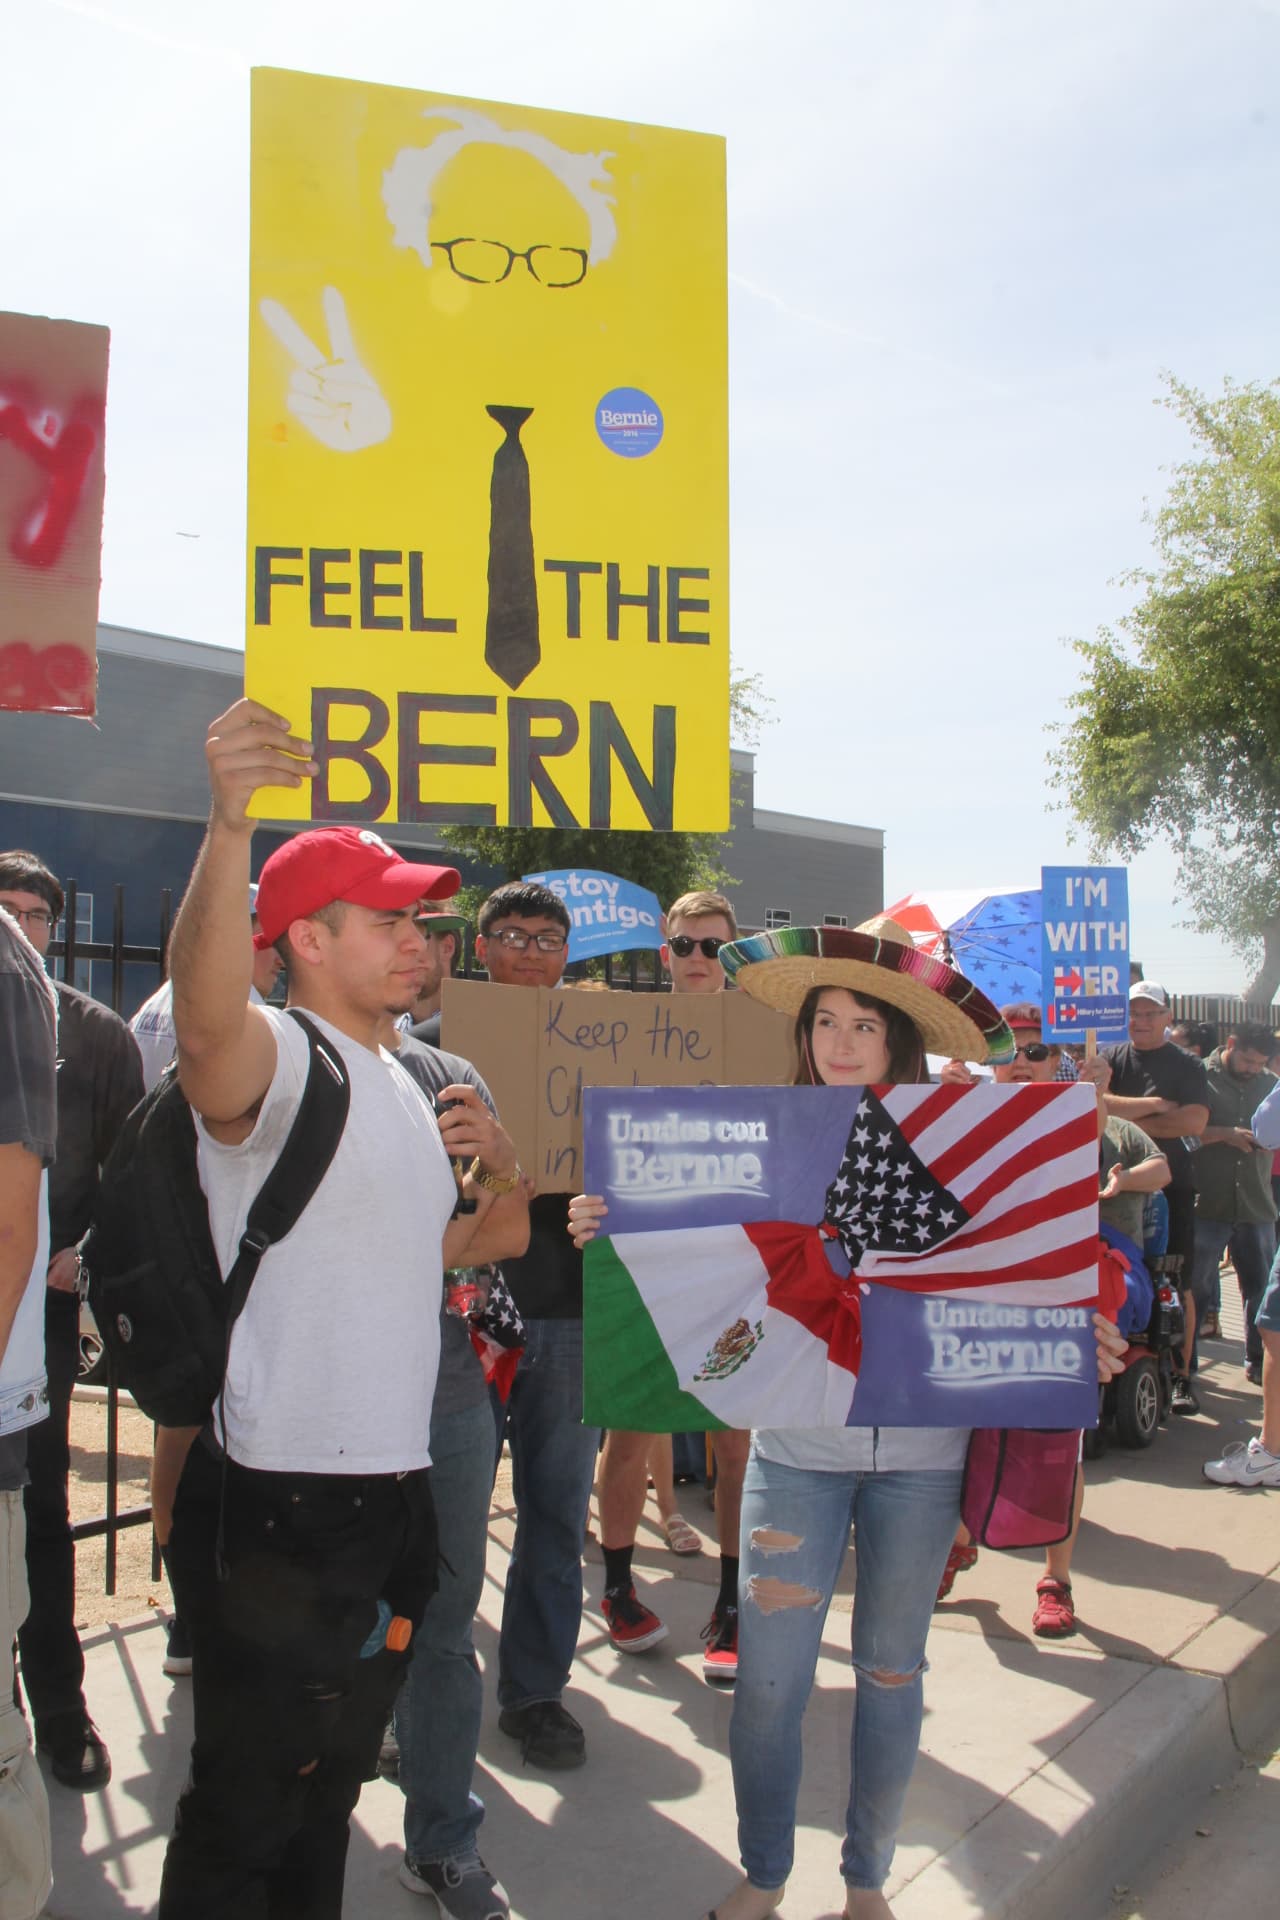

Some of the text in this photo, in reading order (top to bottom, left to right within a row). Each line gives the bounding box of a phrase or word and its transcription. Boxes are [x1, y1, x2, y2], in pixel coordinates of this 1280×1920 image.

[600, 409, 658, 426] Bernie
[254, 546, 710, 645] FEEL THE
[311, 687, 676, 831] BERN
[1065, 877, 1107, 907] I'M
[1045, 921, 1126, 952] WITH
[1054, 966, 1119, 996] HER
[545, 1001, 711, 1064] Keep the
[608, 1112, 768, 1143] Unidos con
[614, 1148, 763, 1187] Bernie
[924, 1299, 1088, 1329] Unidos con
[929, 1332, 1082, 1375] Bernie
